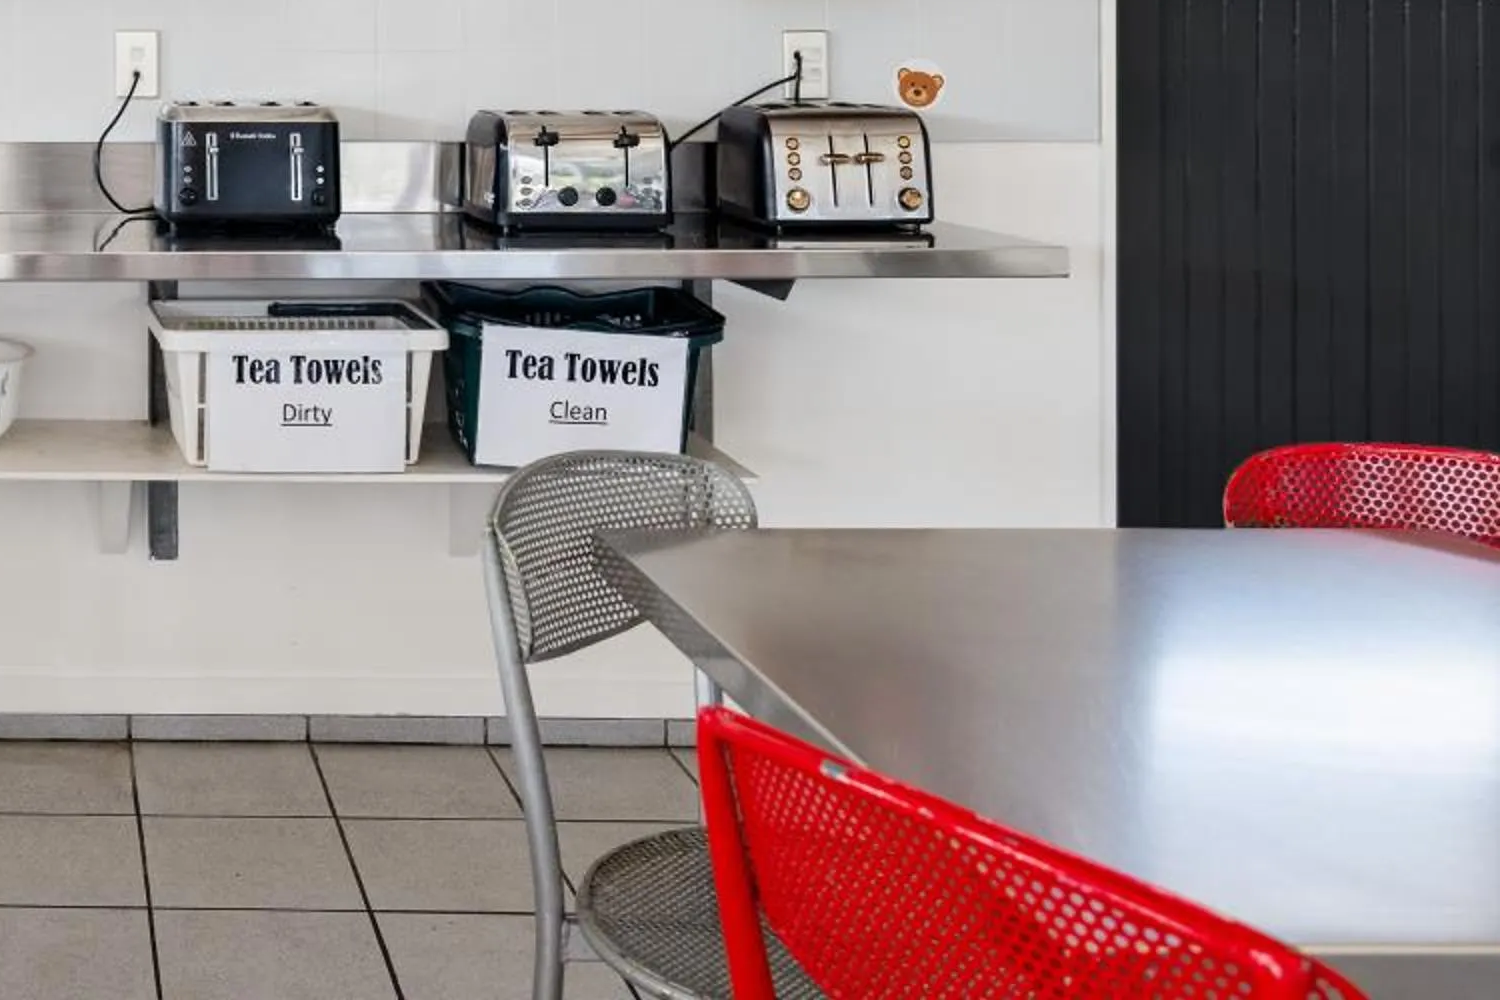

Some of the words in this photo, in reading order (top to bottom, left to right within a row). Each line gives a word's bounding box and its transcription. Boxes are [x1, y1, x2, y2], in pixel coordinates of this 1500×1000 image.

[231, 354, 281, 385] Tea
[289, 354, 384, 385] Towels
[505, 350, 555, 381] Tea
[564, 352, 660, 387] Towels
[282, 403, 333, 426] Dirty
[550, 399, 608, 421] Clean
